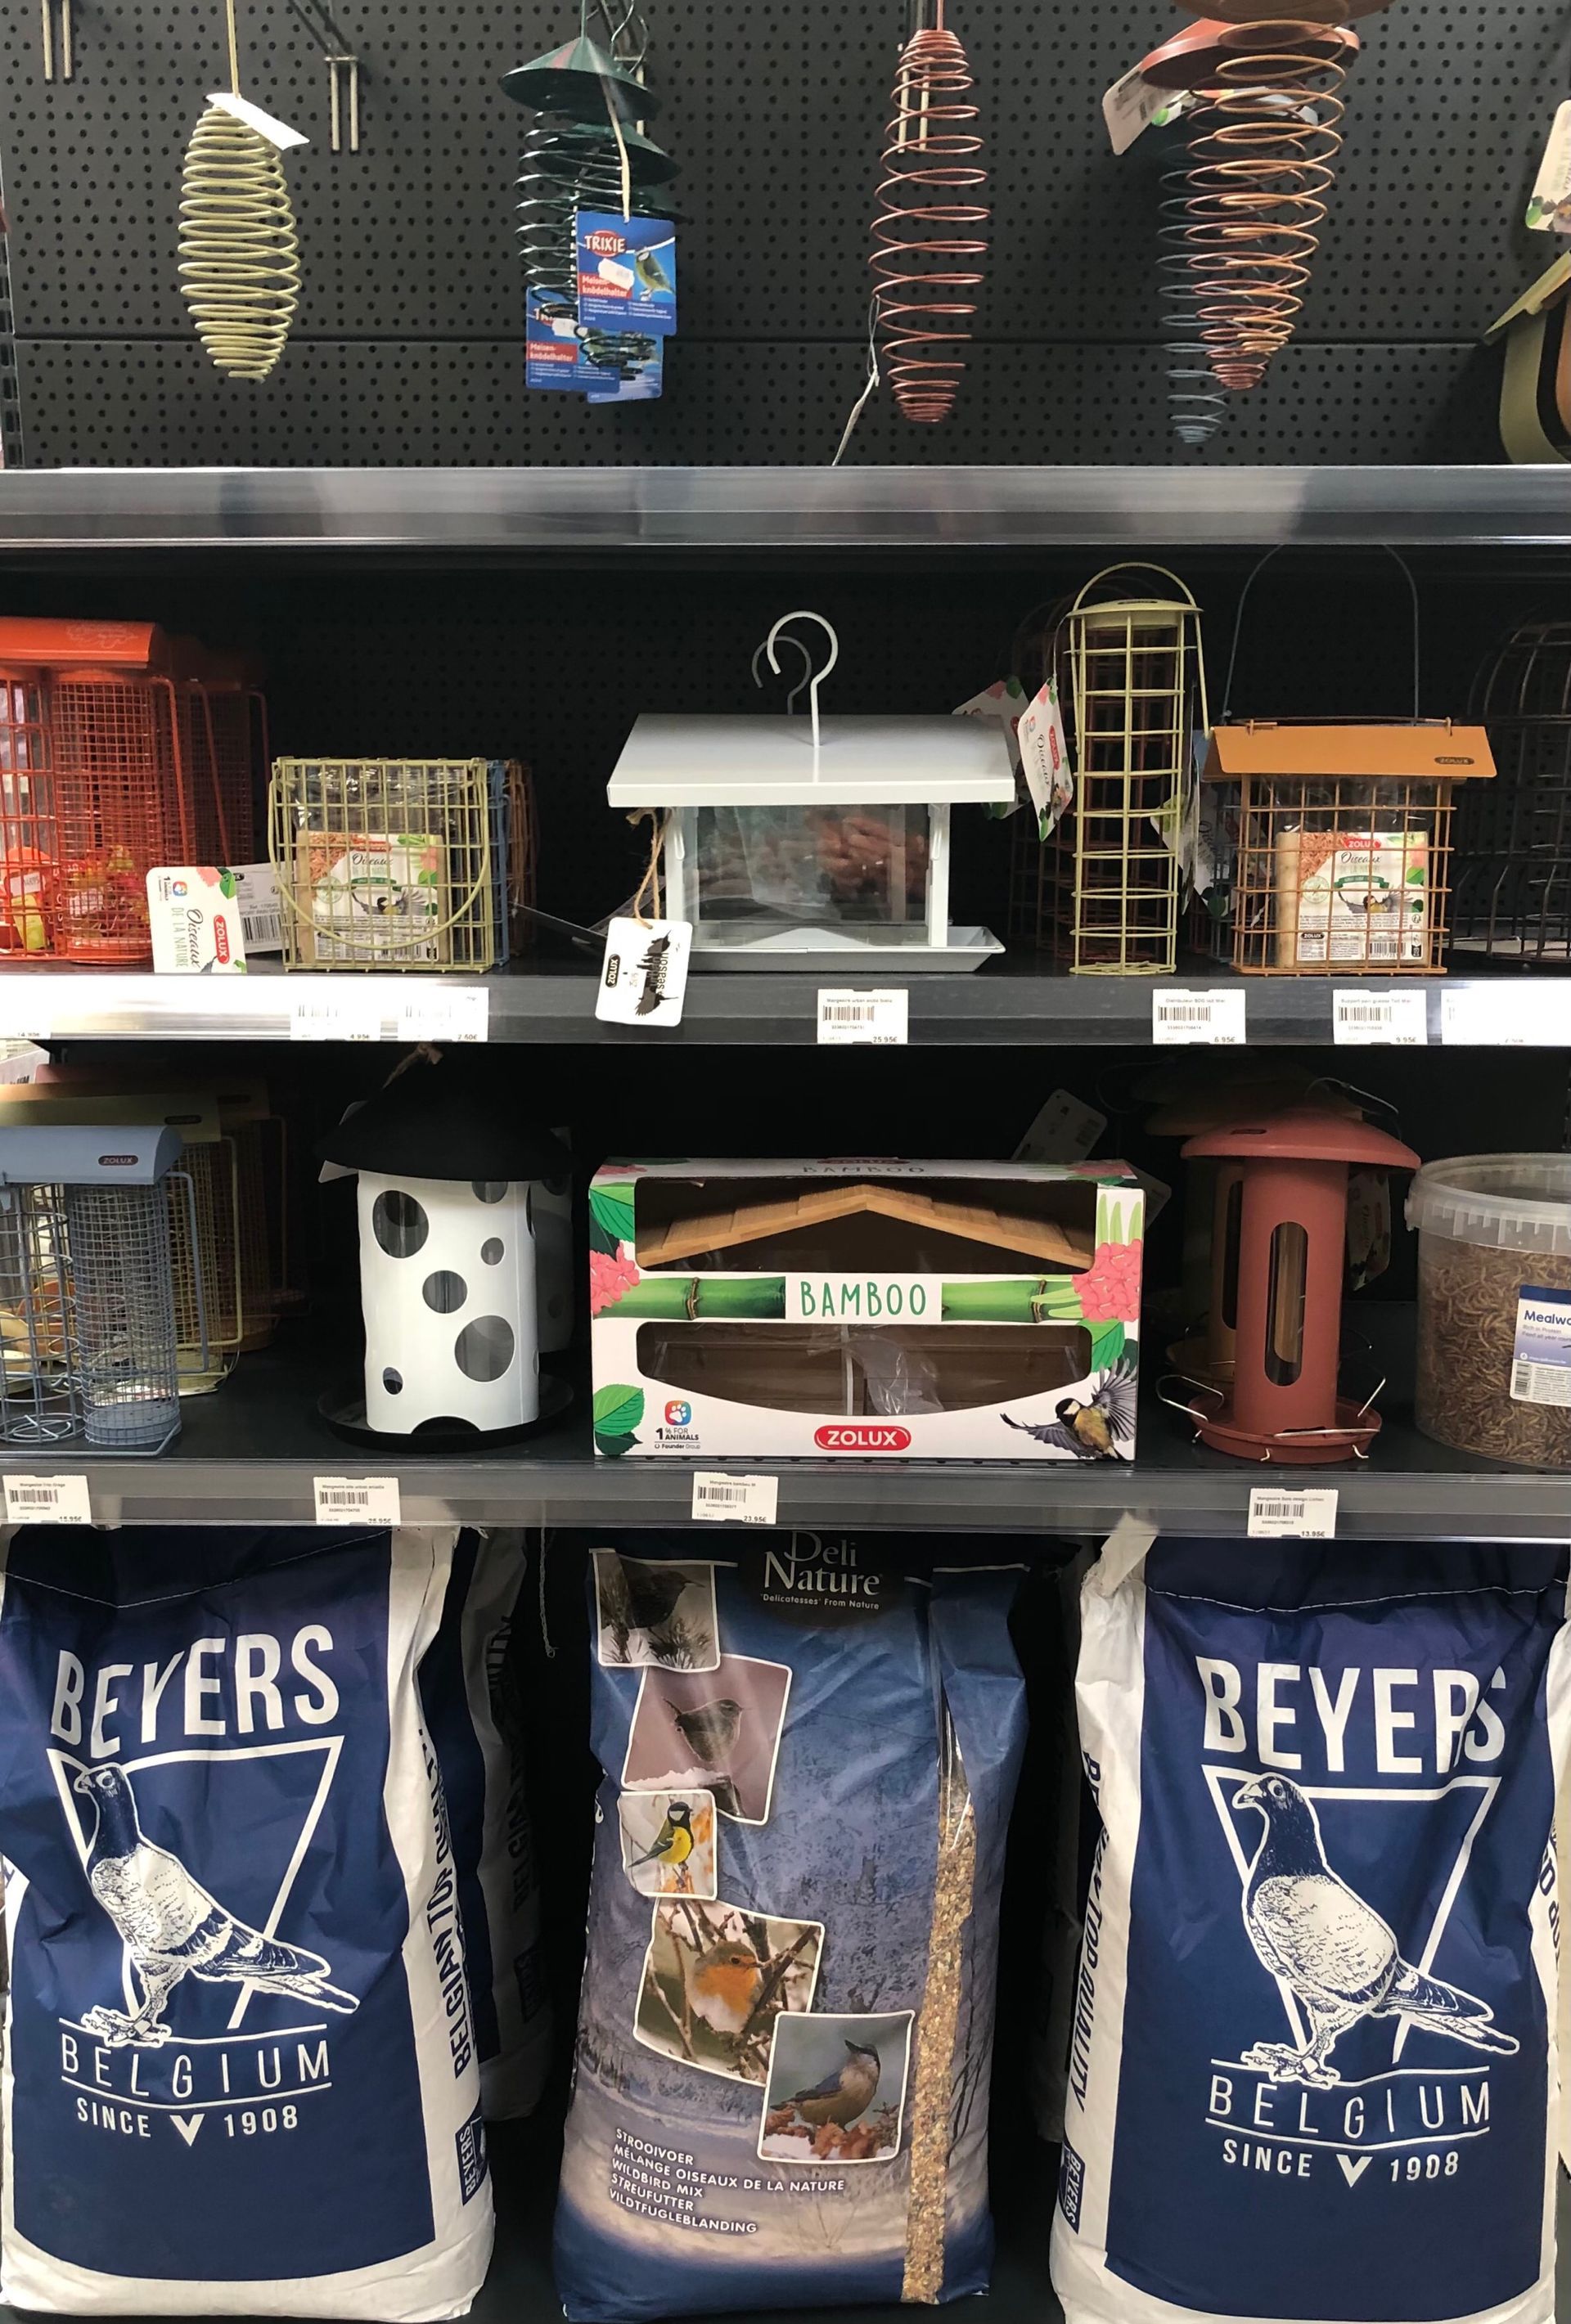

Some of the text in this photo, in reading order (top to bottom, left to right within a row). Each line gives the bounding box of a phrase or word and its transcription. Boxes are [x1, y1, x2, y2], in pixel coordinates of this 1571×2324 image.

[584, 235, 626, 253] TRIXIE
[187, 908, 203, 969] Oiseaux
[215, 921, 228, 957] ZOLUX
[607, 959, 619, 984] ZOLUX
[657, 951, 669, 990] season
[800, 1281, 926, 1317] BAMBOO
[827, 1430, 898, 1446] ZOLUX
[784, 1530, 858, 1567] Deli
[764, 1551, 880, 1595] Nature
[824, 1598, 846, 1607] From
[849, 1600, 880, 1610] Nature
[50, 1624, 340, 1760] BEYERS
[1195, 1656, 1507, 1775] BEYERS
[433, 1932, 472, 2080] BELGIAN
[1069, 1969, 1096, 2113] QUALITY
[61, 2032, 330, 2098] BELGIUM
[77, 2097, 299, 2137] SINCE 1908
[1209, 2075, 1491, 2139] BELGIUM
[460, 2126, 477, 2197] BEYERS
[614, 2144, 845, 2192] MÉLANGE OISEAUX DE LA NATURE
[616, 2128, 694, 2166] STROOIVOER
[1222, 2138, 1460, 2182] SINCE 1908
[611, 2173, 694, 2211] STREUFUTTER
[612, 2158, 704, 2198] WILDBIRD MIX
[1065, 2153, 1082, 2223] BEYERS
[610, 2187, 758, 2234] VILDTFUGLEBLANDING
